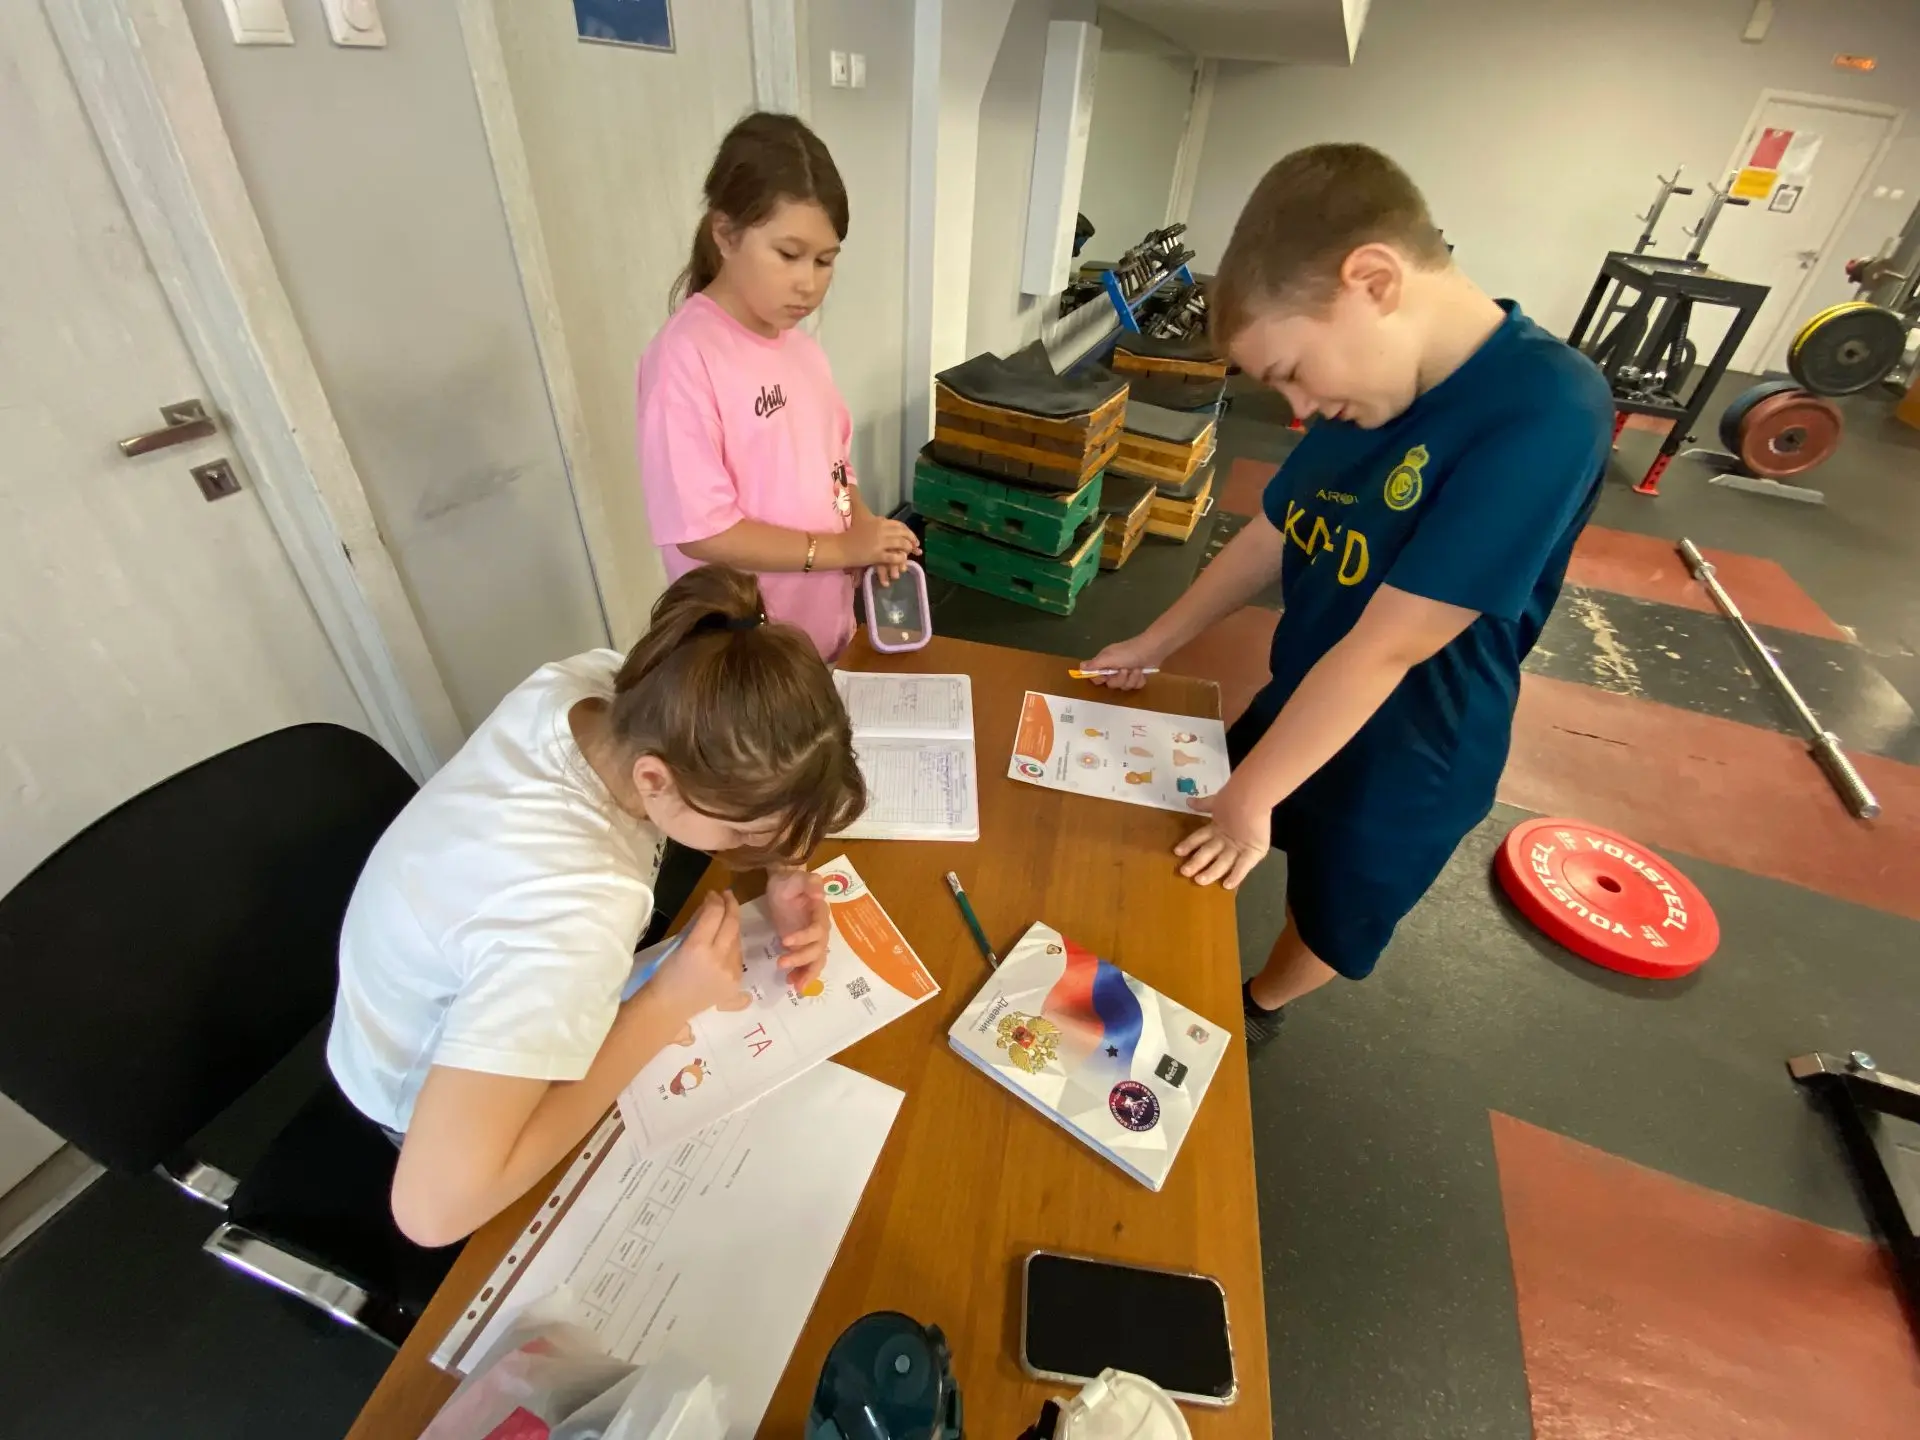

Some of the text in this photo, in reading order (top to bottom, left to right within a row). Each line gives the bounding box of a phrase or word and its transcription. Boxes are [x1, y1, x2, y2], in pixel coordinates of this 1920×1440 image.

[755, 384, 787, 417] chill
[1530, 842, 1633, 939] YOUSTEEL
[1585, 836, 1688, 930] YOUSTEEL
[978, 996, 1009, 1035] Дневник
